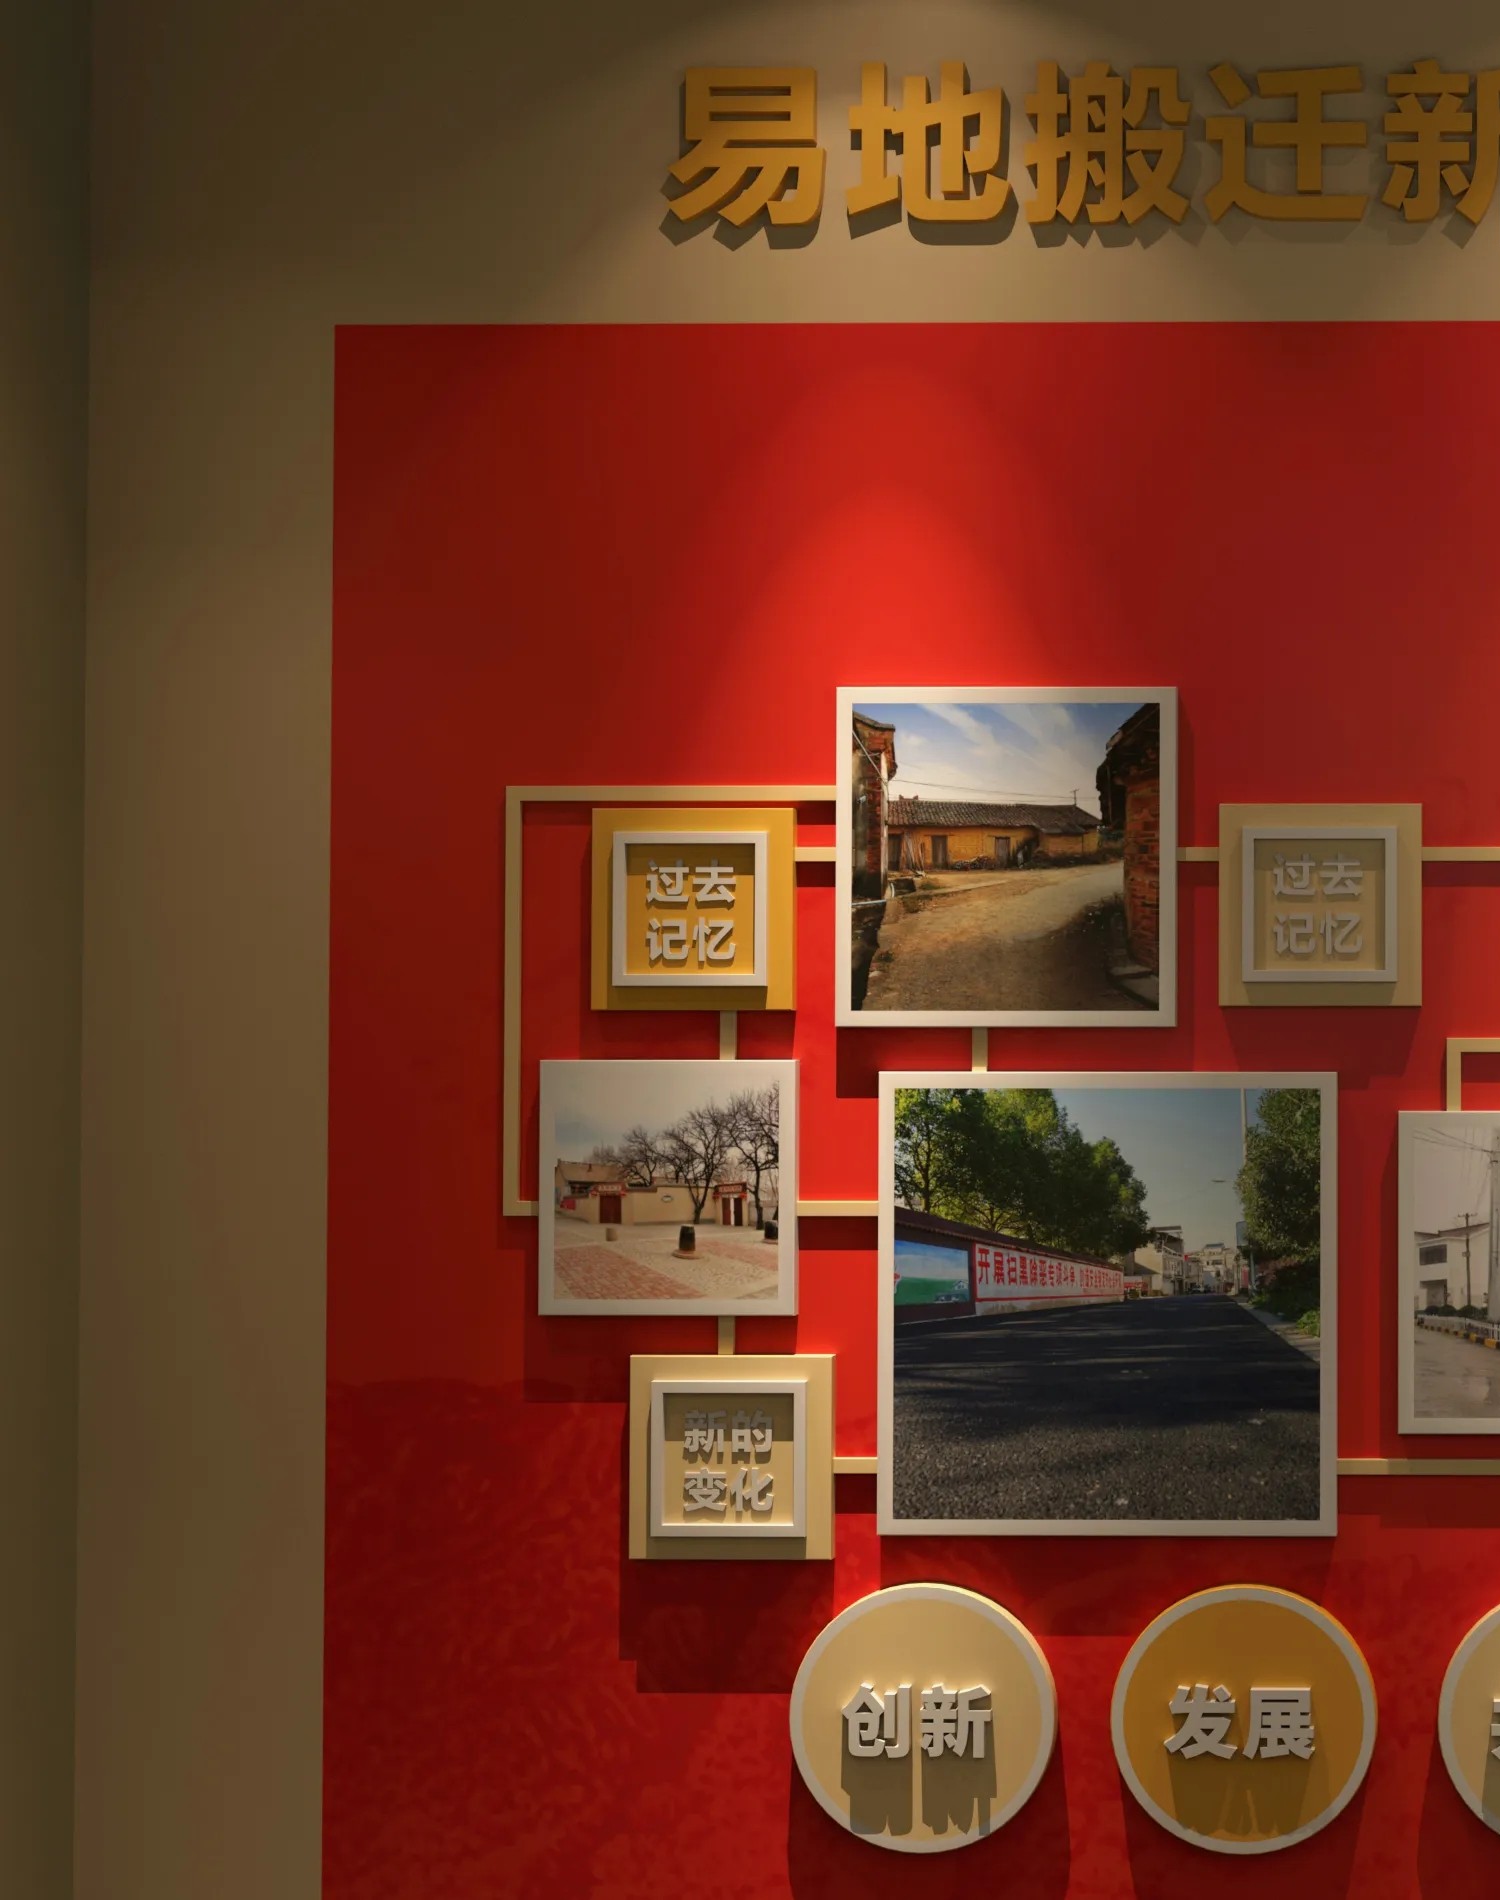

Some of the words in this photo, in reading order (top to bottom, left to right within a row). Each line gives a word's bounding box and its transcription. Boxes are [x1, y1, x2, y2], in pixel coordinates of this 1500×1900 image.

[646, 860, 736, 903] 过去
[1273, 854, 1363, 896] 过去
[646, 917, 736, 962] 记忆
[1273, 911, 1363, 955] 记忆
[683, 1409, 773, 1453] 新的
[683, 1467, 774, 1512] 变化
[841, 1682, 993, 1759] 创新
[1164, 1683, 1316, 1759] 发展
